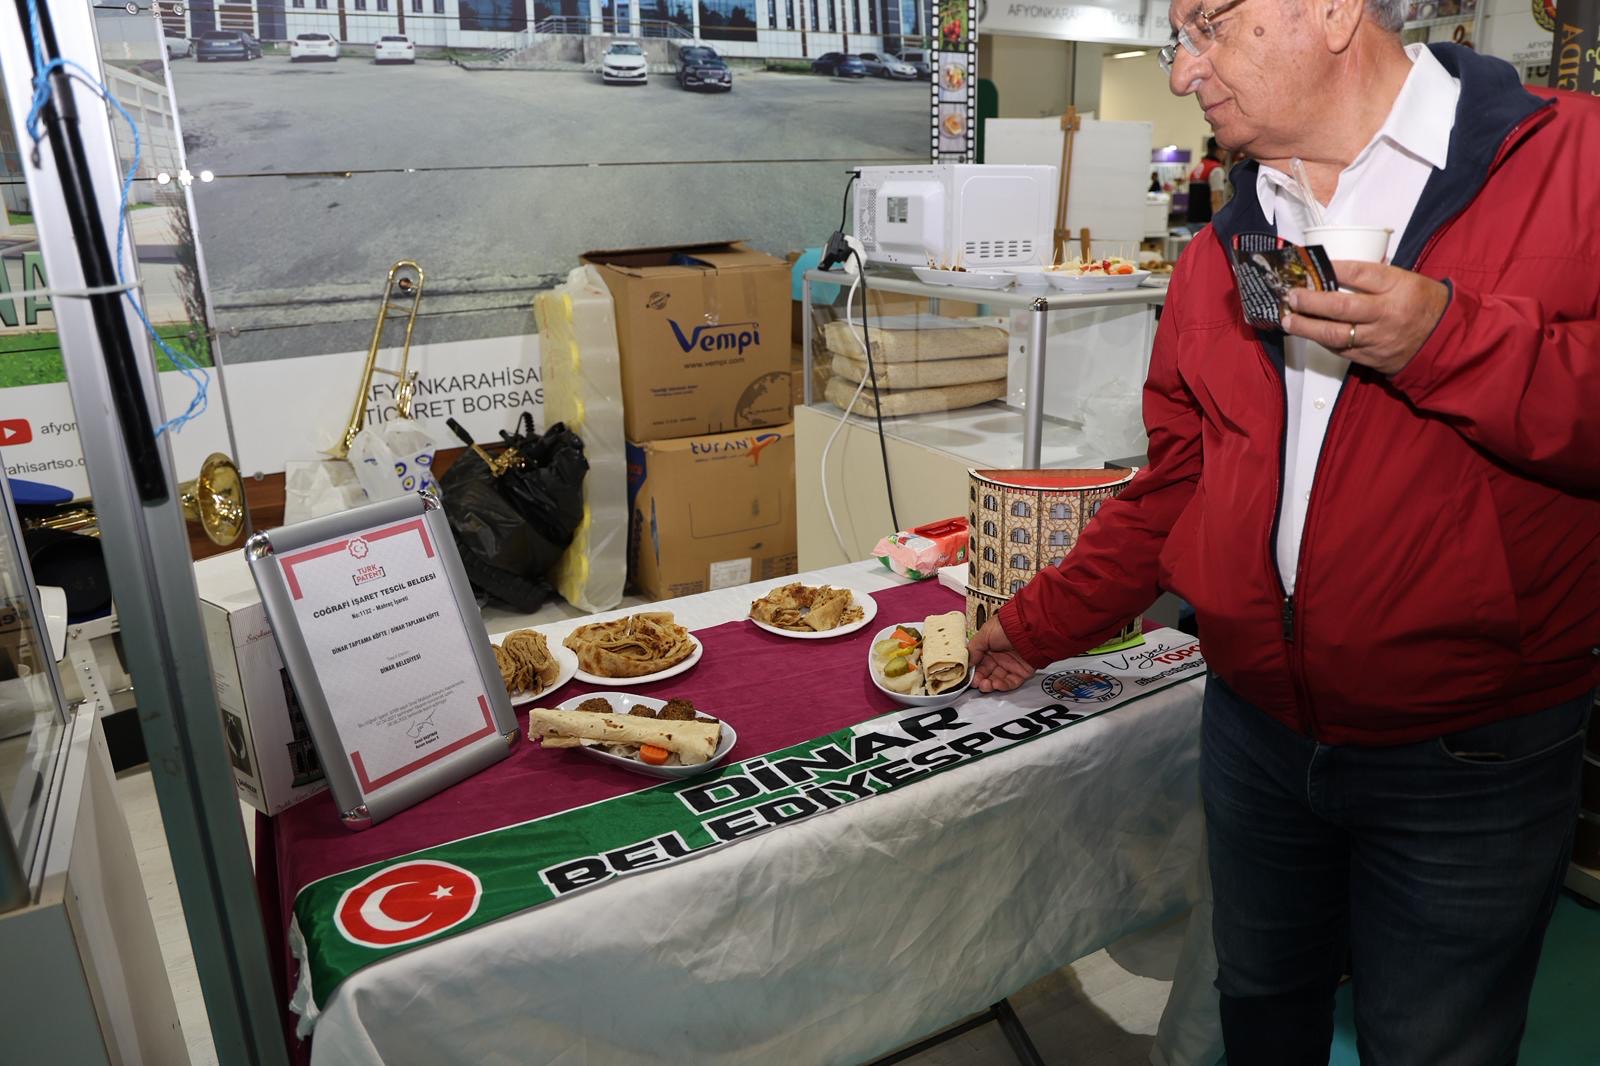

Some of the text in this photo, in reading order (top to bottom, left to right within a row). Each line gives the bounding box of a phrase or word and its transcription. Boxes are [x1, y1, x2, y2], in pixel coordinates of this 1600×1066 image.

[666, 318, 761, 355] Vempi
[313, 572, 436, 619] COĞRAFİ İŞARET TESCİL BELGESİ
[356, 570, 383, 582] PATENT
[332, 644, 349, 655] DİNAR
[348, 635, 373, 649] TAPTAMA
[372, 630, 388, 640] KÖFTE
[390, 622, 406, 633] DİNAR
[405, 616, 427, 628] TAPLAMA
[426, 611, 441, 621] KÖFTE
[380, 664, 396, 674] DİNAR
[396, 653, 421, 668] BELEDİYESİ
[680, 706, 973, 815] DİNAR
[542, 703, 1085, 895] BELEDİYESPOR
